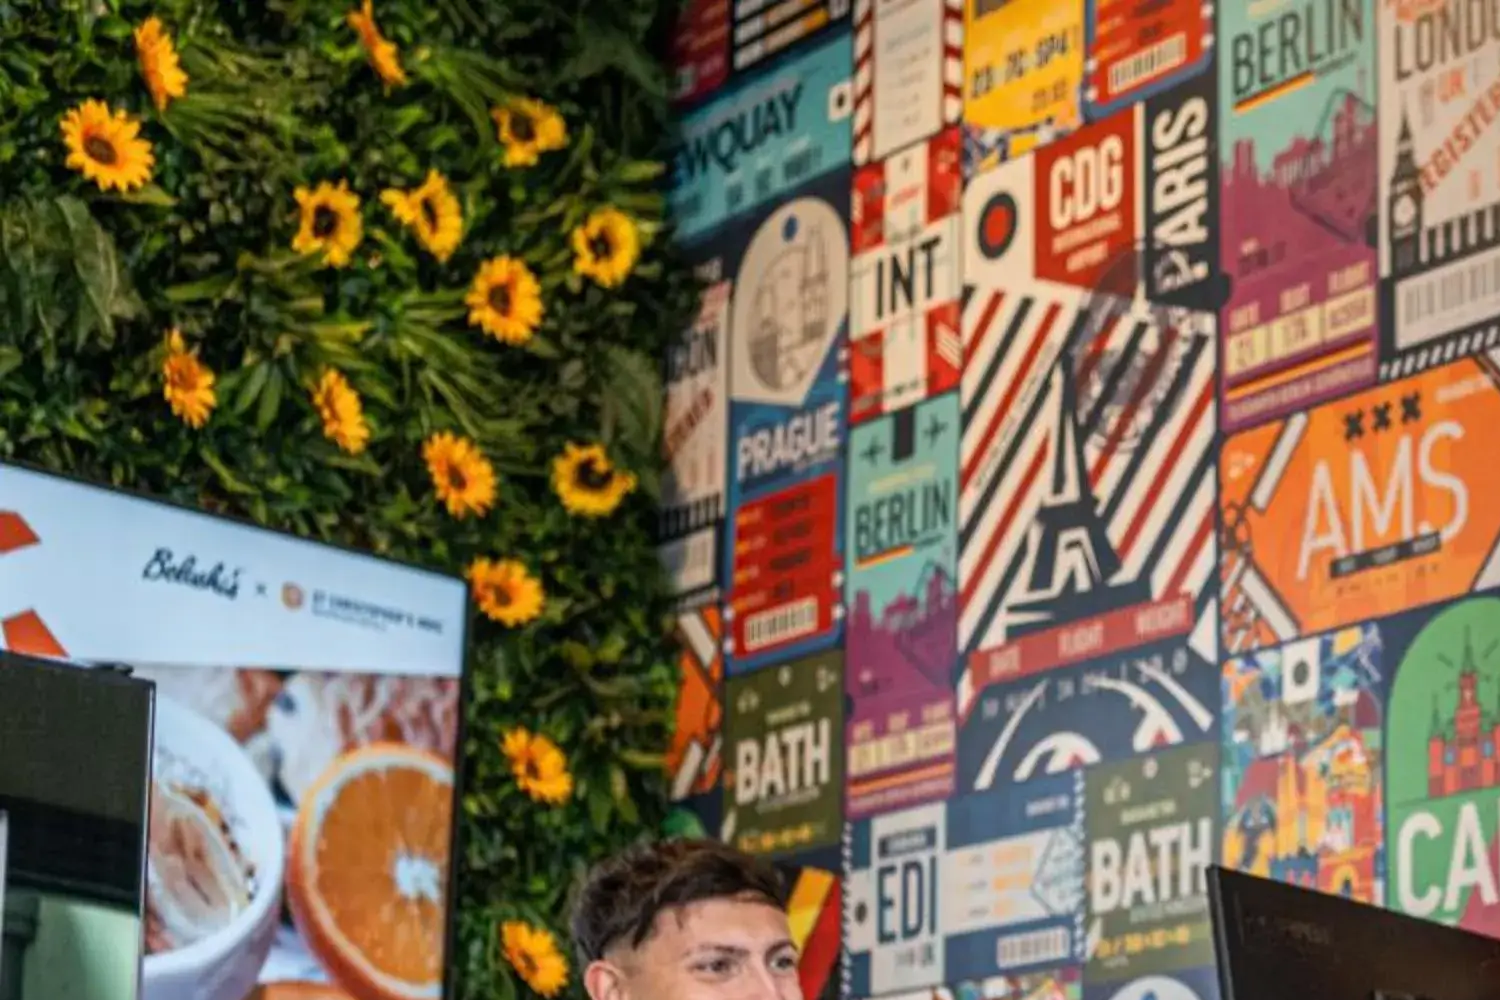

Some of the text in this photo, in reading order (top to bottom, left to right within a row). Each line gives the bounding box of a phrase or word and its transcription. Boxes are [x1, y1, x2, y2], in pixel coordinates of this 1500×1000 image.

[1232, 0, 1364, 97] BERLIN
[1049, 134, 1124, 231] CDG
[1152, 96, 1209, 295] PARIS
[876, 235, 942, 320] INT
[736, 402, 841, 481] PRAGUE
[855, 479, 951, 555] BERLIN
[1296, 420, 1469, 580] AMS
[735, 716, 831, 807] BATH
[877, 854, 937, 945] EDI
[1091, 816, 1213, 915] BATH
